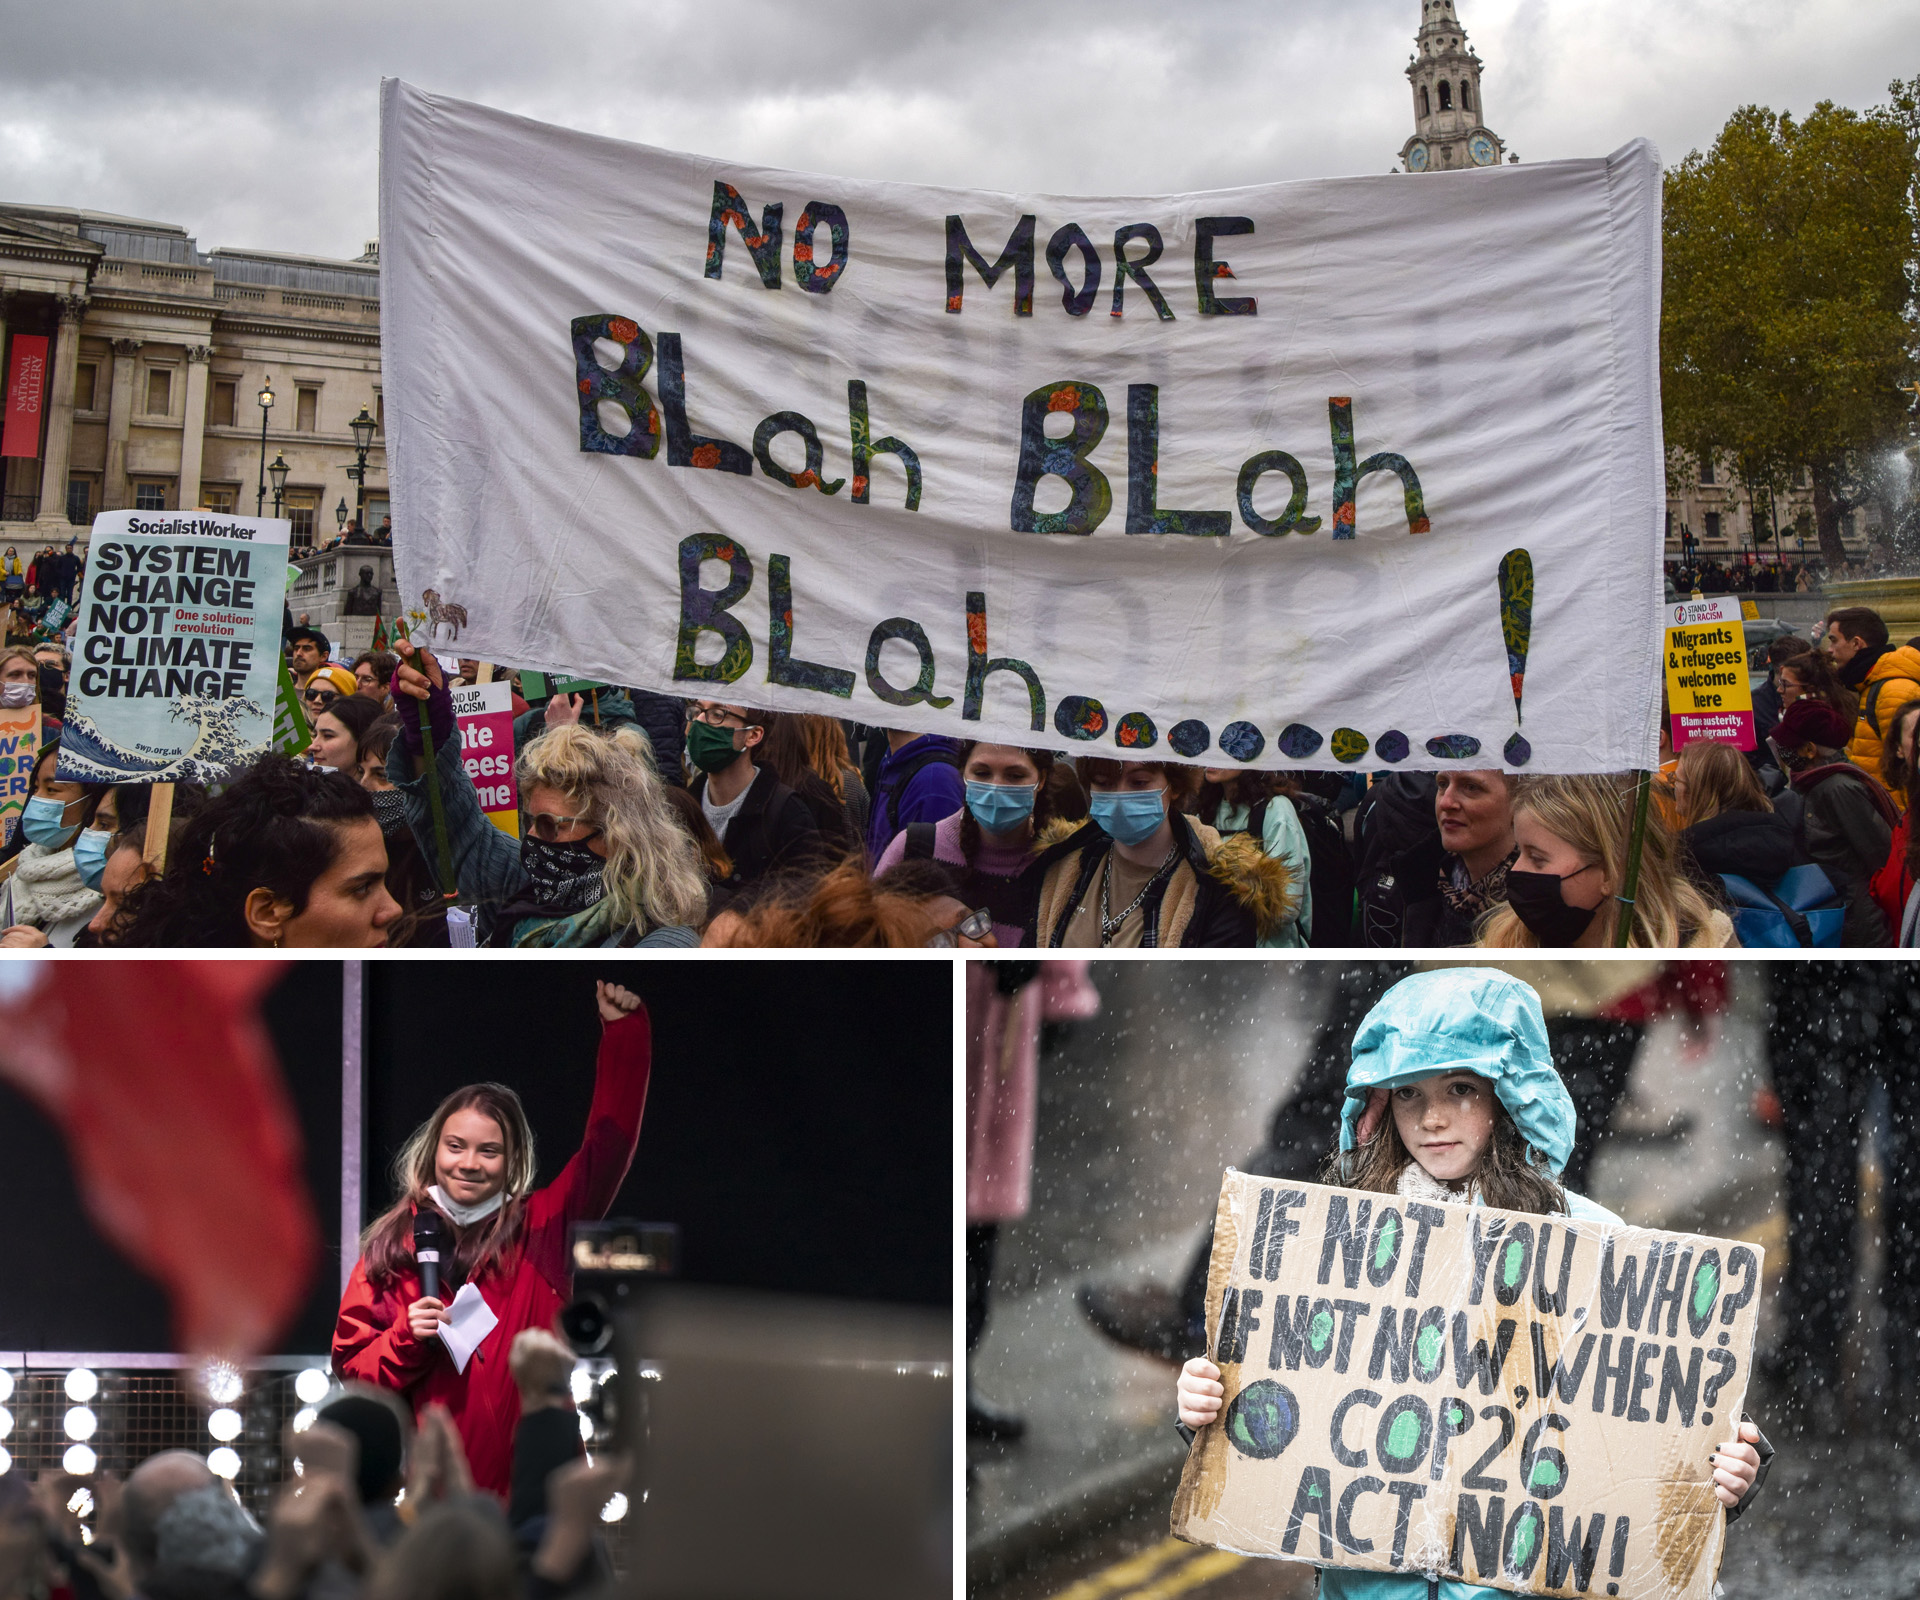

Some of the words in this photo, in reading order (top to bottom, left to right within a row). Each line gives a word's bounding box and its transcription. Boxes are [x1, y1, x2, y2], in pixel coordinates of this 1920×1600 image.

[704, 180, 849, 293] NO
[945, 214, 1258, 321] MORE
[17, 354, 31, 412] NATIONAL
[27, 355, 43, 413] GALLERY
[571, 313, 922, 512] BLah
[1010, 380, 1431, 540] BLah
[95, 542, 250, 578] SYSTEM
[93, 573, 256, 609] CHANGE
[88, 603, 170, 635] NOT
[175, 609, 199, 621] One
[202, 610, 254, 626] solution:
[1687, 604, 1707, 613] STAND
[1708, 603, 1717, 611] UP
[1688, 614, 1696, 622] TO
[1697, 611, 1723, 621] RACISM
[174, 622, 235, 636] revolution
[1671, 628, 1732, 651] Migrants
[84, 635, 253, 671] CLIMATE
[1669, 652, 1679, 669] &
[1681, 650, 1742, 670] refugees
[79, 667, 247, 700] CHANGE
[550, 676, 568, 686] TRADE
[1678, 670, 1736, 688] welcome
[452, 701, 486, 714] RACISM
[467, 691, 480, 702] UP
[1692, 691, 1722, 707] here
[1688, 728, 1701, 737] not
[135, 742, 182, 756] swp.org.uk
[462, 754, 510, 778] ees
[1249, 1187, 1307, 1282] IF
[1321, 1194, 1446, 1298] NOT
[1467, 1208, 1588, 1334] YOU,
[1598, 1235, 1757, 1347] WHO?
[1218, 1288, 1260, 1364] IF
[1268, 1294, 1370, 1375] NOT
[1530, 1321, 1737, 1428] WHEN?
[1330, 1388, 1572, 1501] COP26
[1280, 1466, 1428, 1568] ACT
[1450, 1493, 1630, 1597] NOW!
